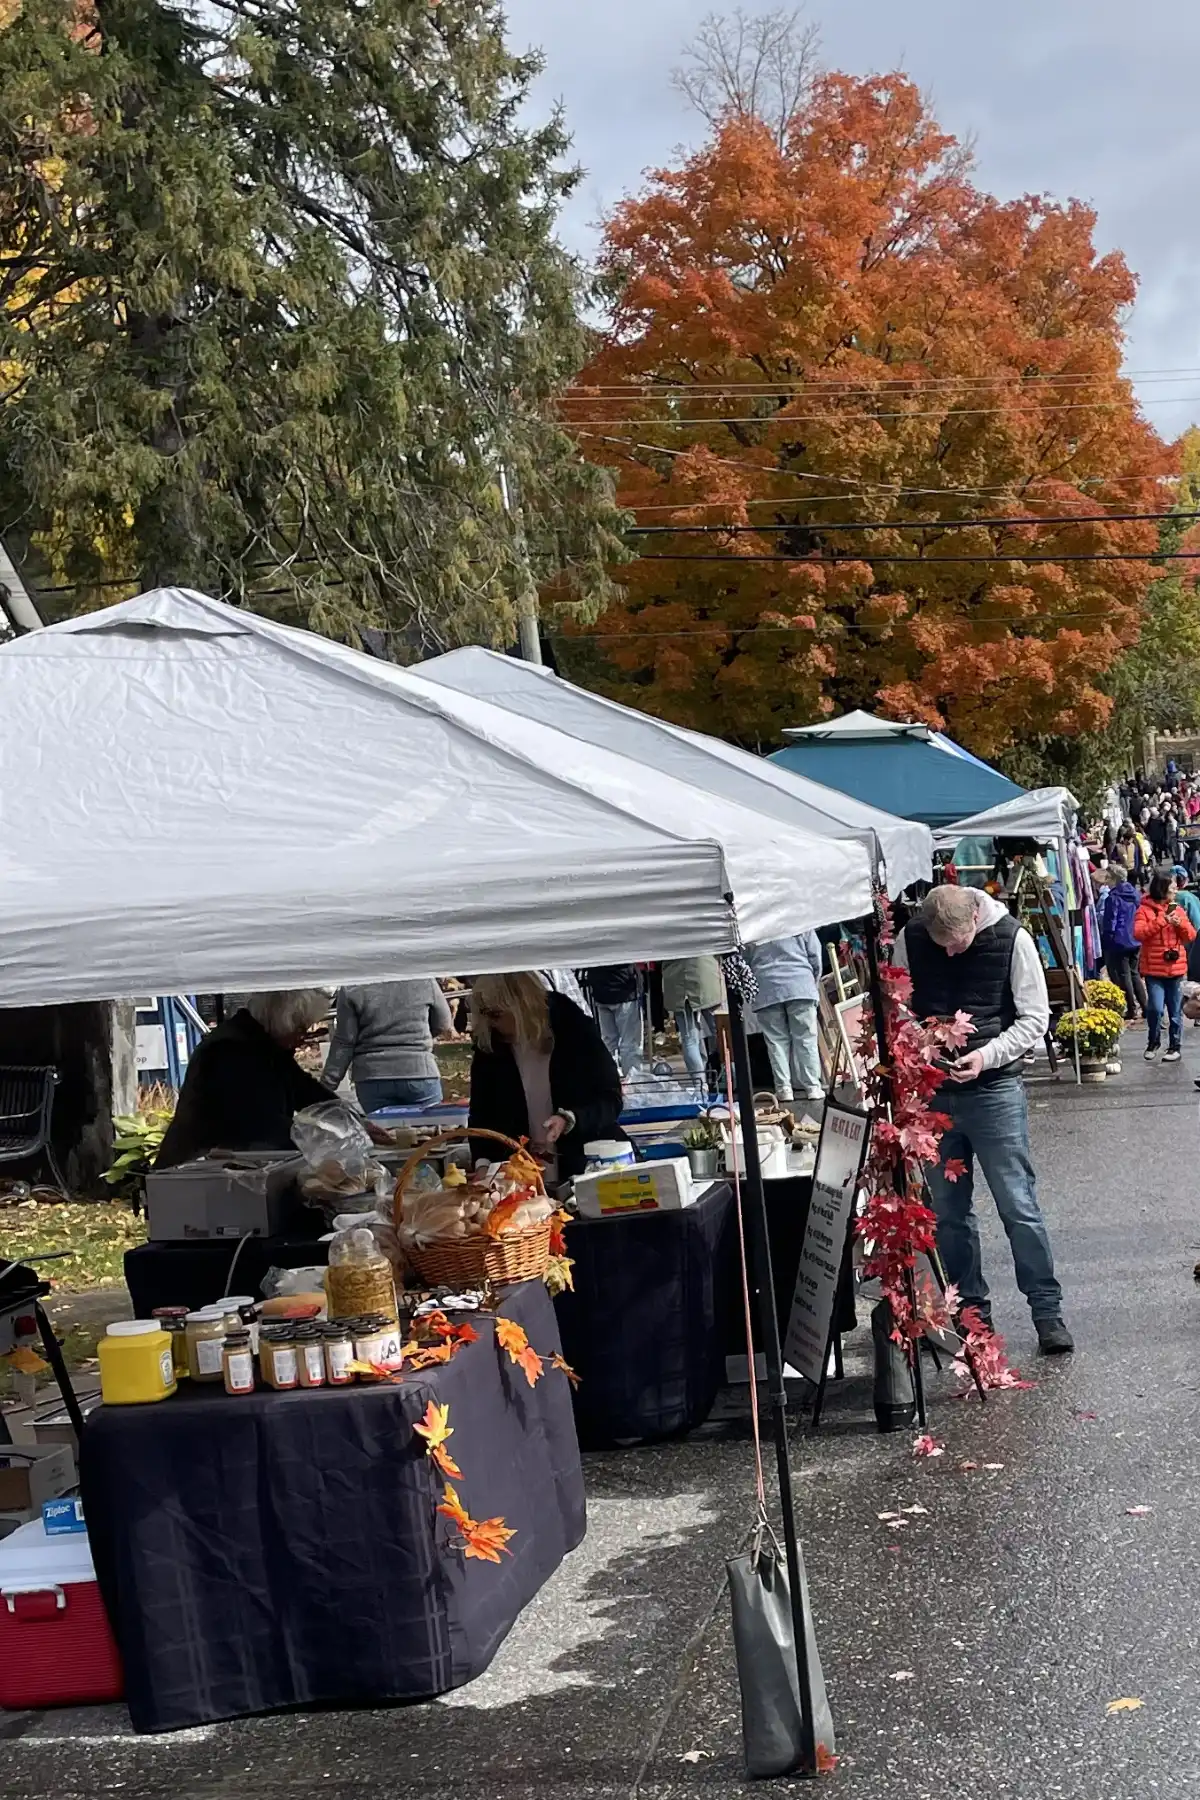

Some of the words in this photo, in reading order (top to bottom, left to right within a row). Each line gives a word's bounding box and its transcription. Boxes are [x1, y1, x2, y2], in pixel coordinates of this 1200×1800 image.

[831, 1116, 846, 1135] HEAT
[849, 1122, 862, 1141] EAT
[45, 1504, 71, 1518] Ziploc
